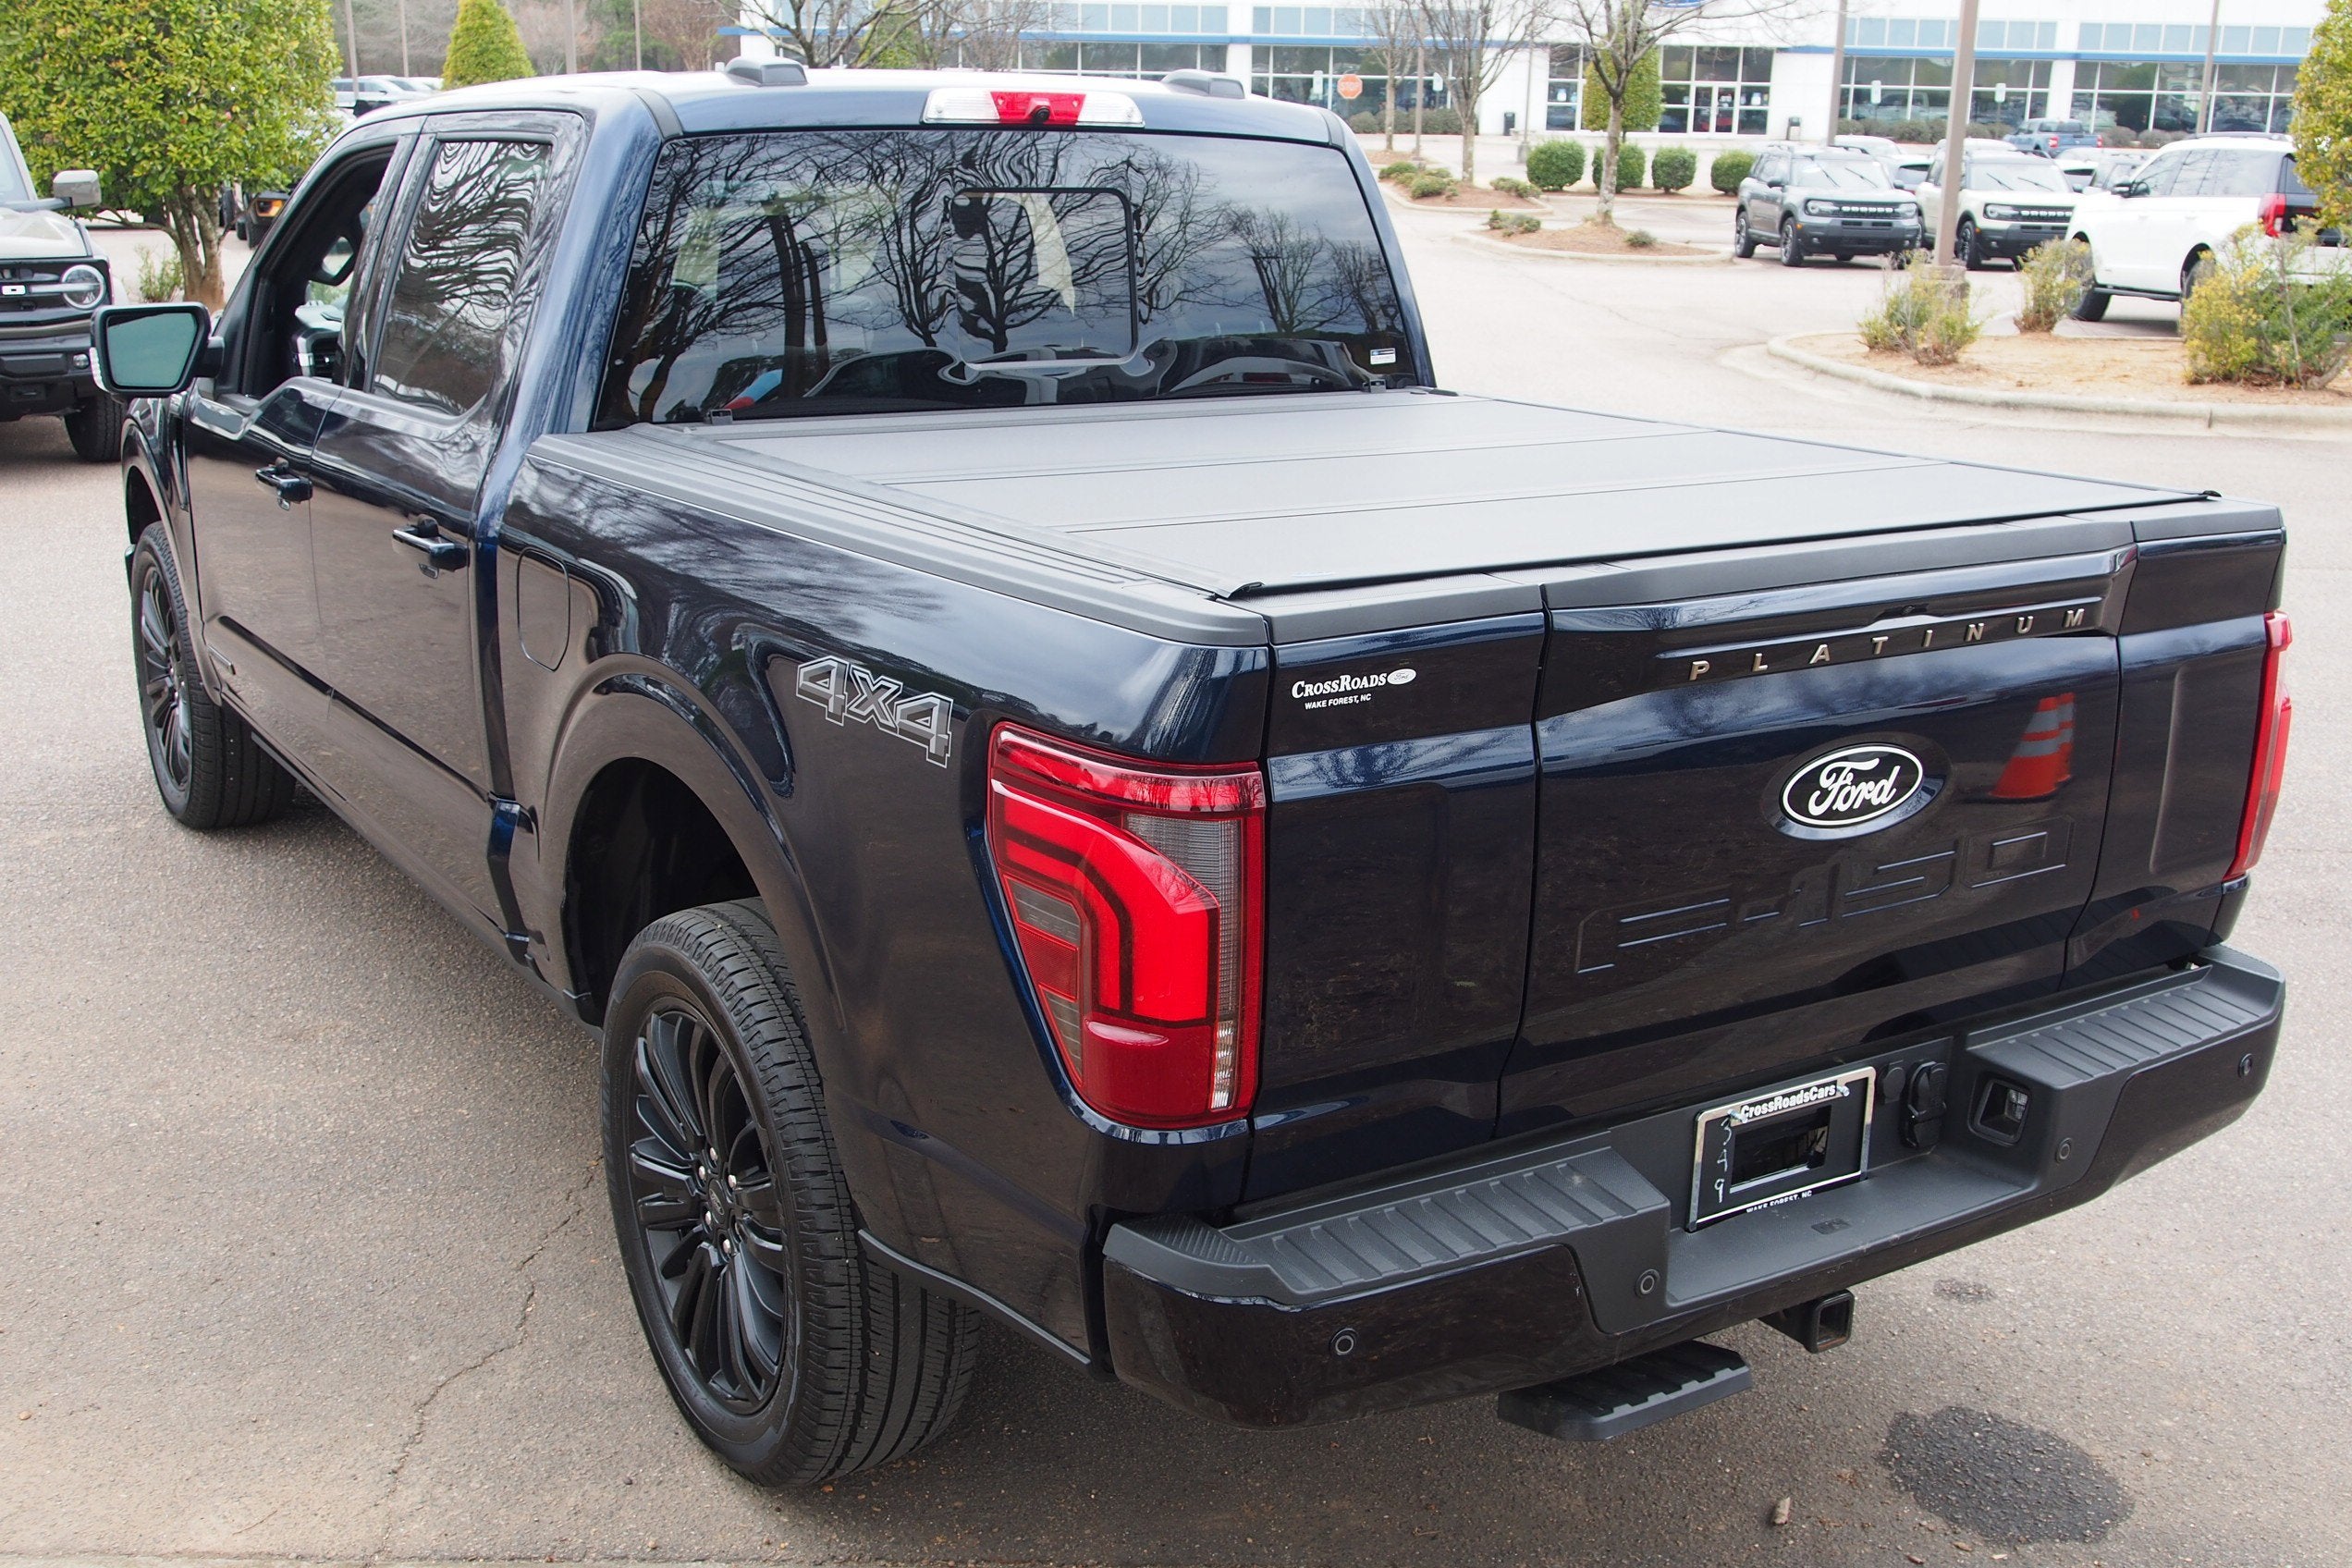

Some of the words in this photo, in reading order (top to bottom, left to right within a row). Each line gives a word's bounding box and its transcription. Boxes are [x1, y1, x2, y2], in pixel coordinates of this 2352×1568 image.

[1689, 608, 2085, 680] PLATINUM
[1305, 700, 1327, 710] WAKE
[1329, 695, 1359, 706] FOREST,
[1360, 693, 1372, 702] NC
[1807, 757, 1901, 815] Ford
[1741, 1084, 1835, 1119] CrossRoadsCars
